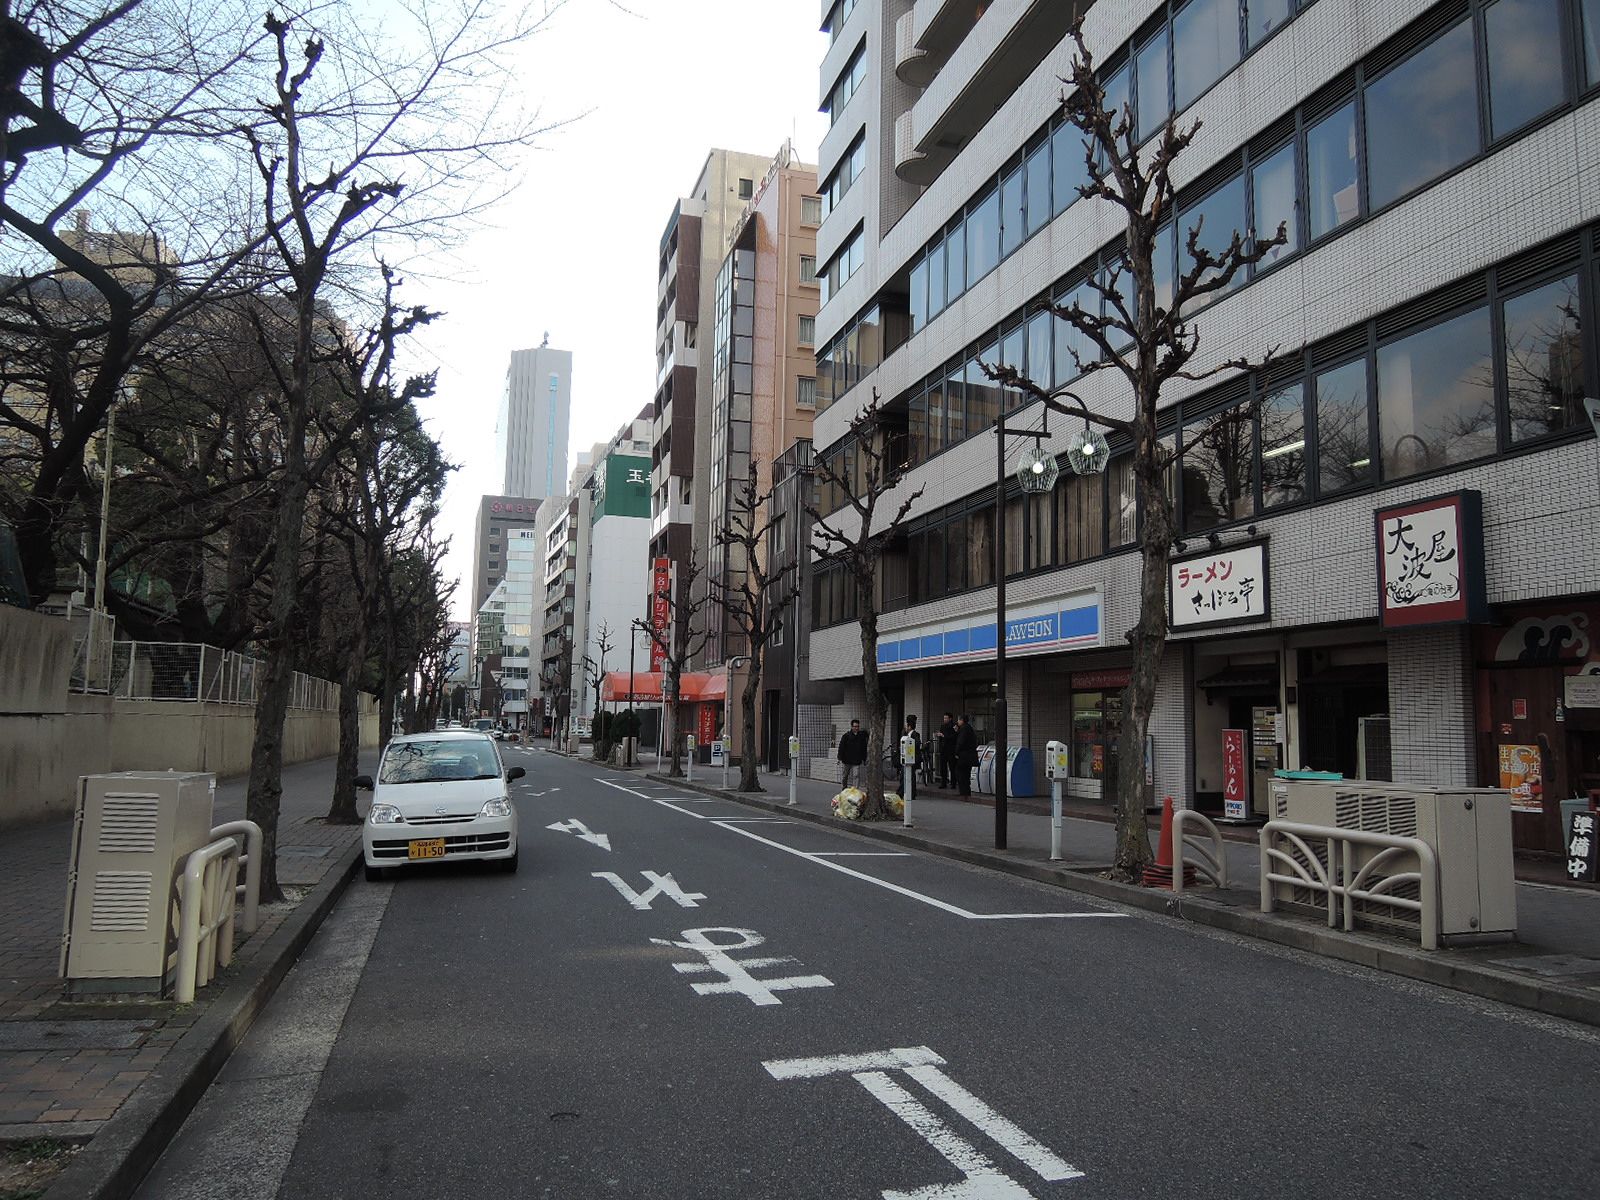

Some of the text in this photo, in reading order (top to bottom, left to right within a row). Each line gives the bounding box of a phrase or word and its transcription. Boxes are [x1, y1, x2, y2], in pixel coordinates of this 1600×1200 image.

[1178, 560, 1232, 588] ラーメン
[1386, 518, 1456, 582] 大波屋
[1226, 736, 1238, 795] らーめん
[1567, 814, 1594, 879] 準備中
